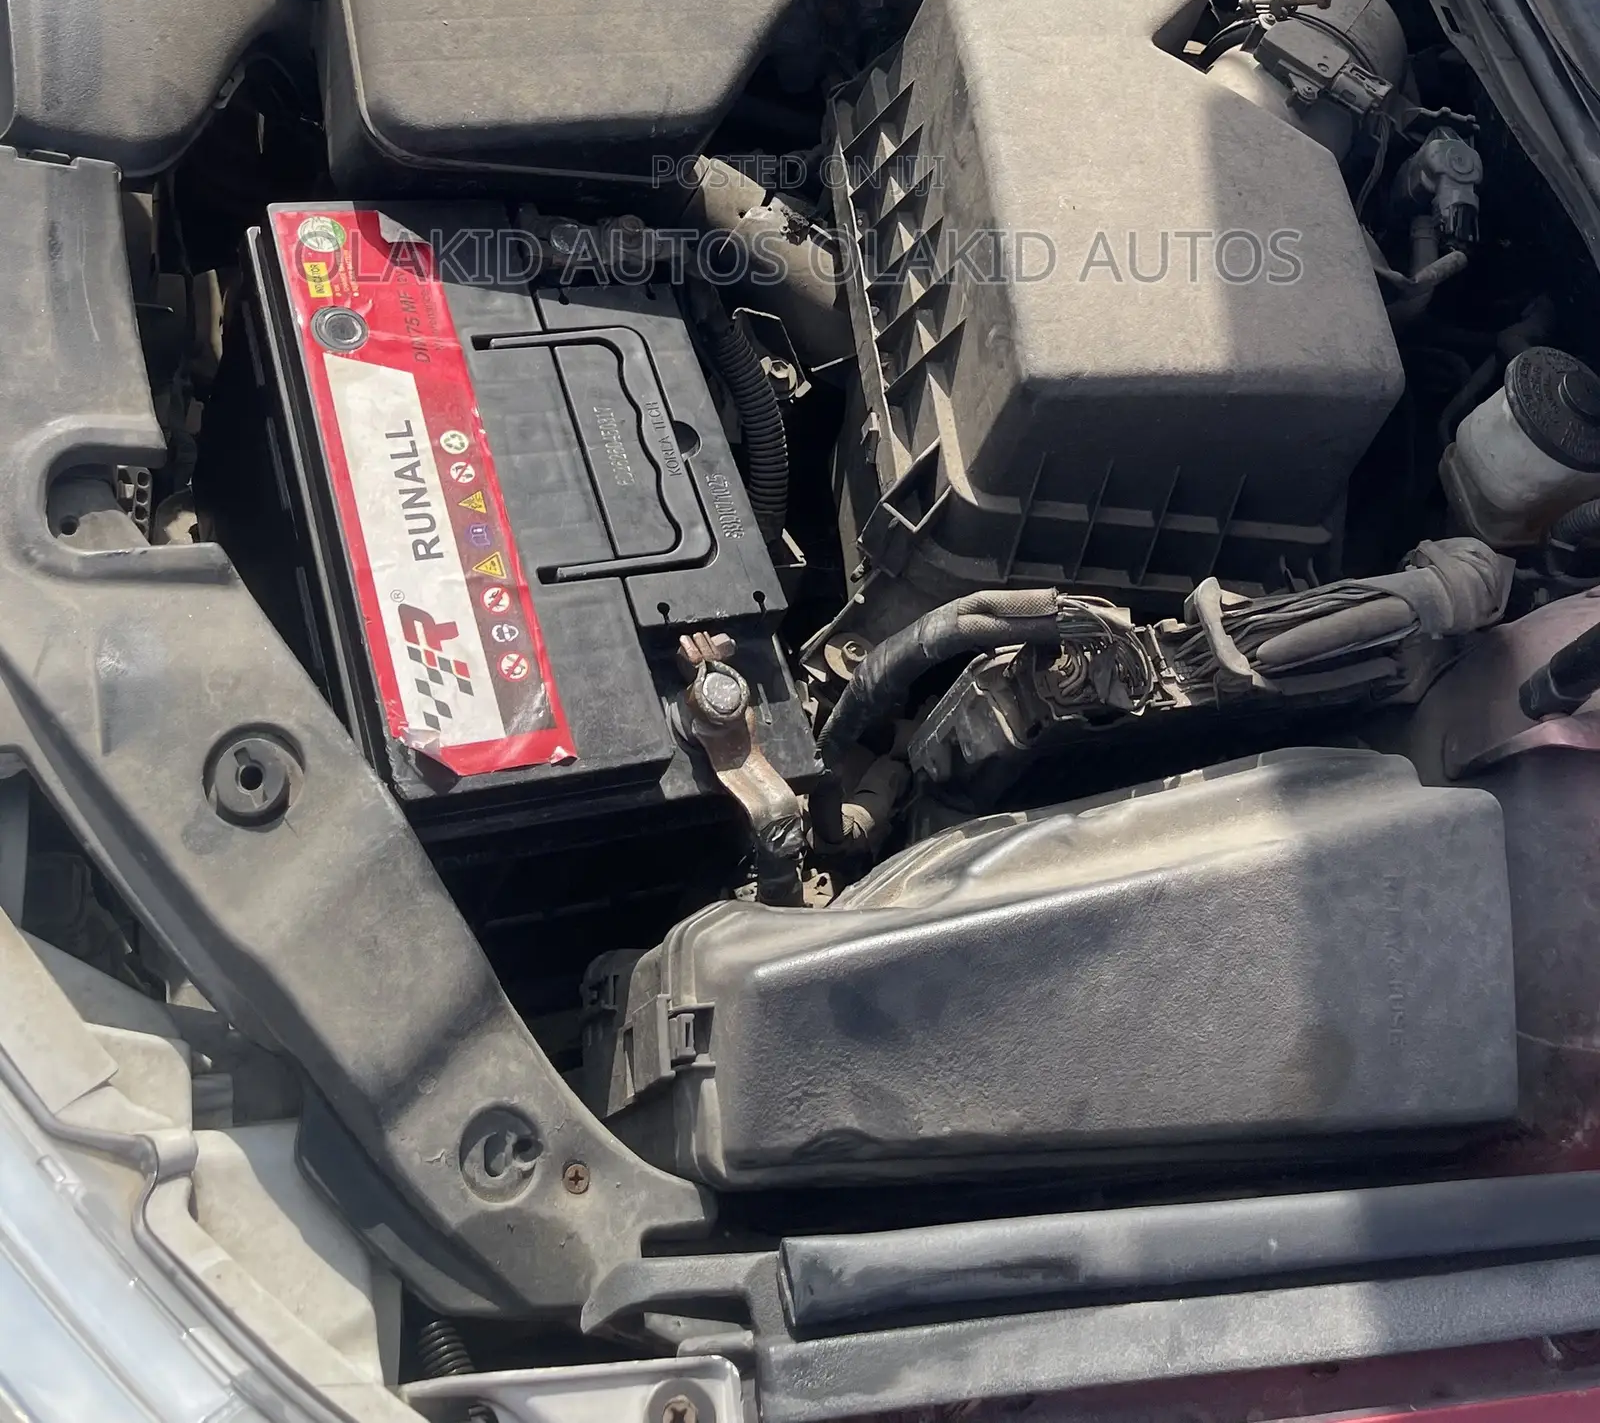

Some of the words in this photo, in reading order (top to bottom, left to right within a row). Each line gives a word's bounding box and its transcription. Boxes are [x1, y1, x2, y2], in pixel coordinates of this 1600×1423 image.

[309, 264, 325, 294] INDICATOR
[645, 400, 667, 431] TECH
[657, 435, 683, 478] KOREA
[384, 419, 444, 562] RUNALL
